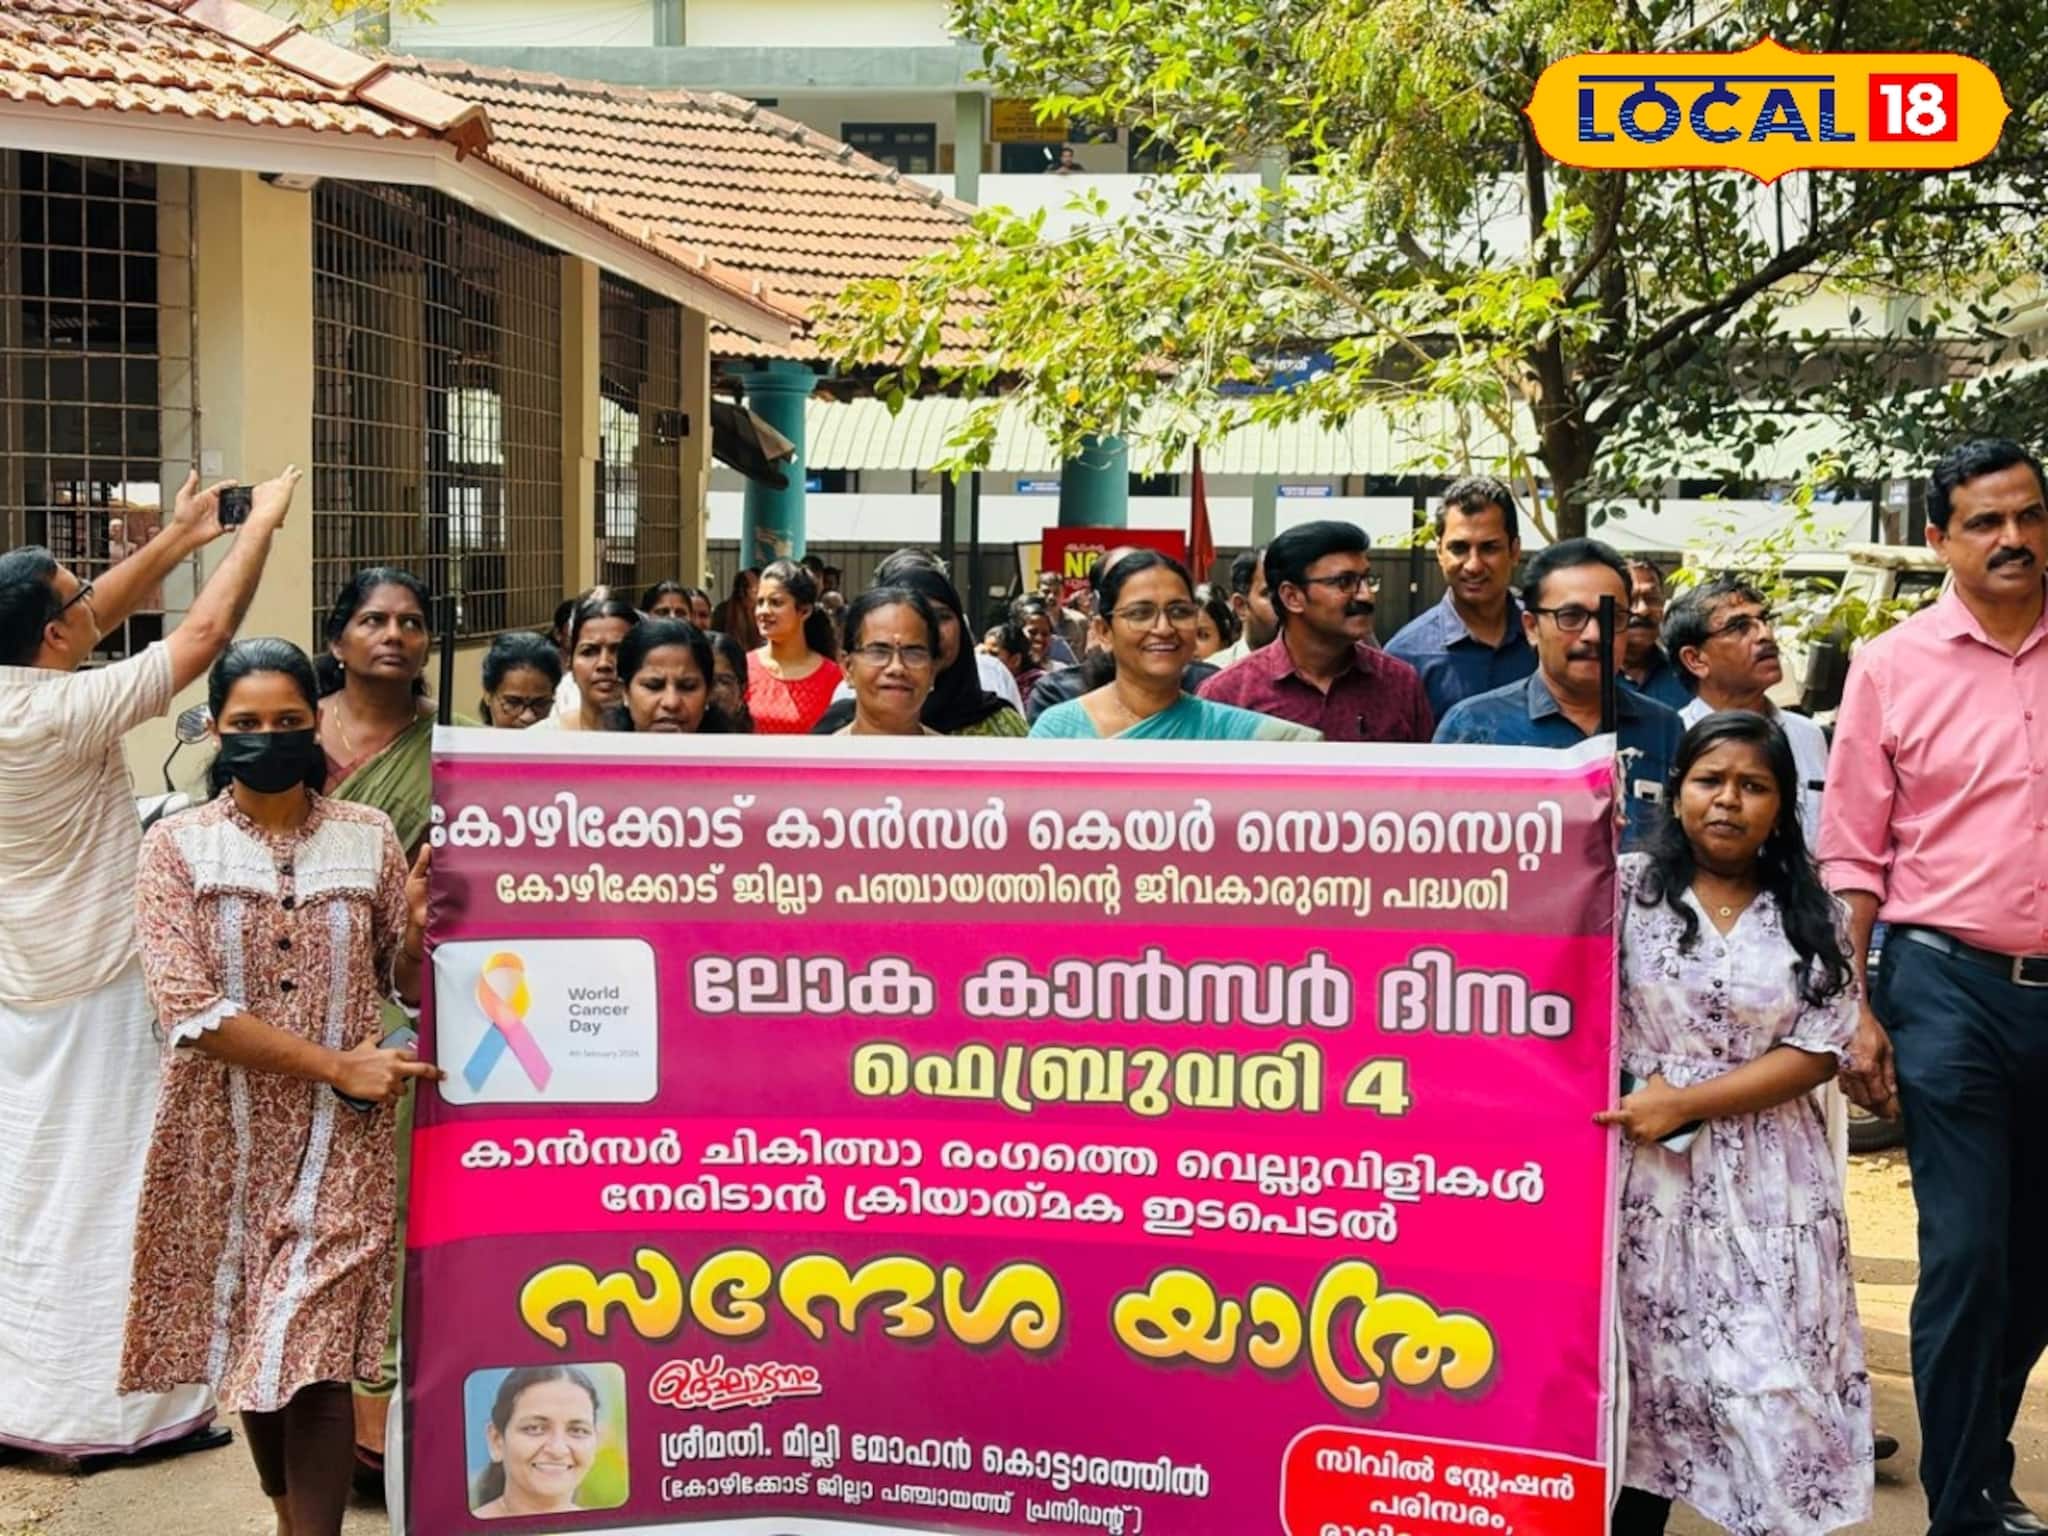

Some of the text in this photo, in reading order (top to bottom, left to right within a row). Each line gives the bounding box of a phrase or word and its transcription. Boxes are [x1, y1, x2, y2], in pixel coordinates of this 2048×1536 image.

[429, 791, 1564, 872] കോഴിക്കോട് കാൻസർ കെയർ സൊസൈറ്റി
[496, 862, 725, 904] കോഴിക്കോട്
[733, 862, 823, 915] ജില്ലാ
[1135, 866, 1371, 918] ജീവകാരുണ്യ
[1383, 870, 1509, 912] പദ്ധതി
[568, 986, 620, 1001] World
[568, 1003, 630, 1017] Cancer
[693, 946, 1574, 1038] ലോക കാൻസർ ദിനം
[569, 1019, 602, 1036] Day
[852, 1042, 1411, 1116] ഫെബ്രുവരി 4
[460, 1129, 1544, 1204] കാൻസർ ചികിത്സാ രംഗത്തെ വെല്ലുവിളികൾ
[601, 1176, 826, 1214] നേരിടാൻ
[1143, 1196, 1399, 1244] ഇടപെടൽ
[520, 1248, 1495, 1410] സന്ദേശ യാത്ര
[661, 1424, 1210, 1498] ശ്രീമതി. മില്ലി മോഹൻ കൊട്ടാരത്തിൽ
[1315, 1446, 1575, 1502] സിവിൽ സ്റ്റേഷൻ
[662, 1472, 812, 1501] (കോഴിക്കോട്
[816, 1473, 873, 1504] ജില്ലാ
[881, 1482, 1014, 1515] പഞ്ചായത്ത്
[1369, 1491, 1514, 1536] പരിസരം,
